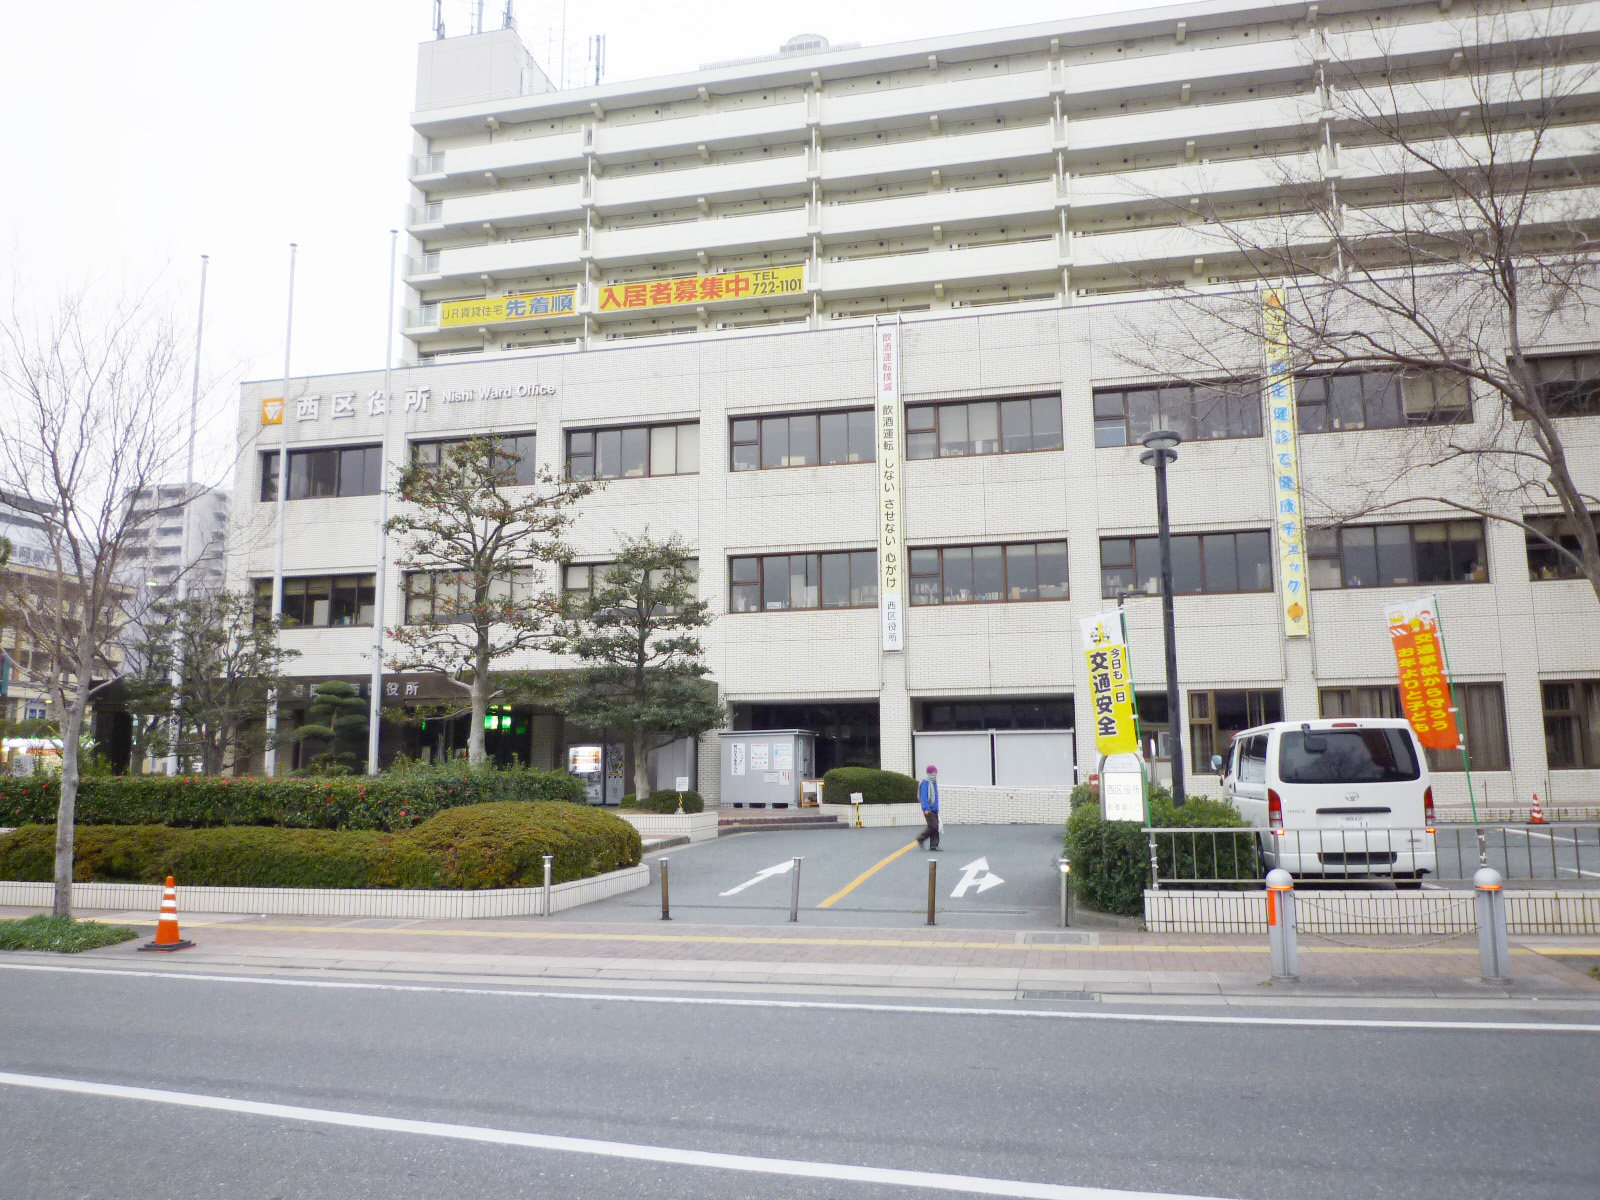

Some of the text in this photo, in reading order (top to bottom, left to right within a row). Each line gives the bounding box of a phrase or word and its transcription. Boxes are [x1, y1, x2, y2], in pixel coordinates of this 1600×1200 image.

[600, 274, 750, 310] 入居者募集中
[752, 278, 802, 295] 722-1101
[753, 271, 779, 281] TEL
[442, 294, 573, 320] UR賃貸住宅 先着順
[882, 332, 893, 392] 飲酒運転撲滅
[296, 385, 431, 423] 西区役所
[442, 383, 556, 404] Nishi Ward Office
[882, 404, 897, 588] 飲酒運転 しない させない 心がけ
[887, 600, 897, 642] 西区役所
[1089, 651, 1117, 737] 交通安全
[1110, 648, 1125, 703] 今日も一日
[1397, 647, 1430, 733] お年よりと子ども
[1413, 632, 1448, 731] 交通事故から守ろう
[1106, 784, 1140, 795] 西区役所
